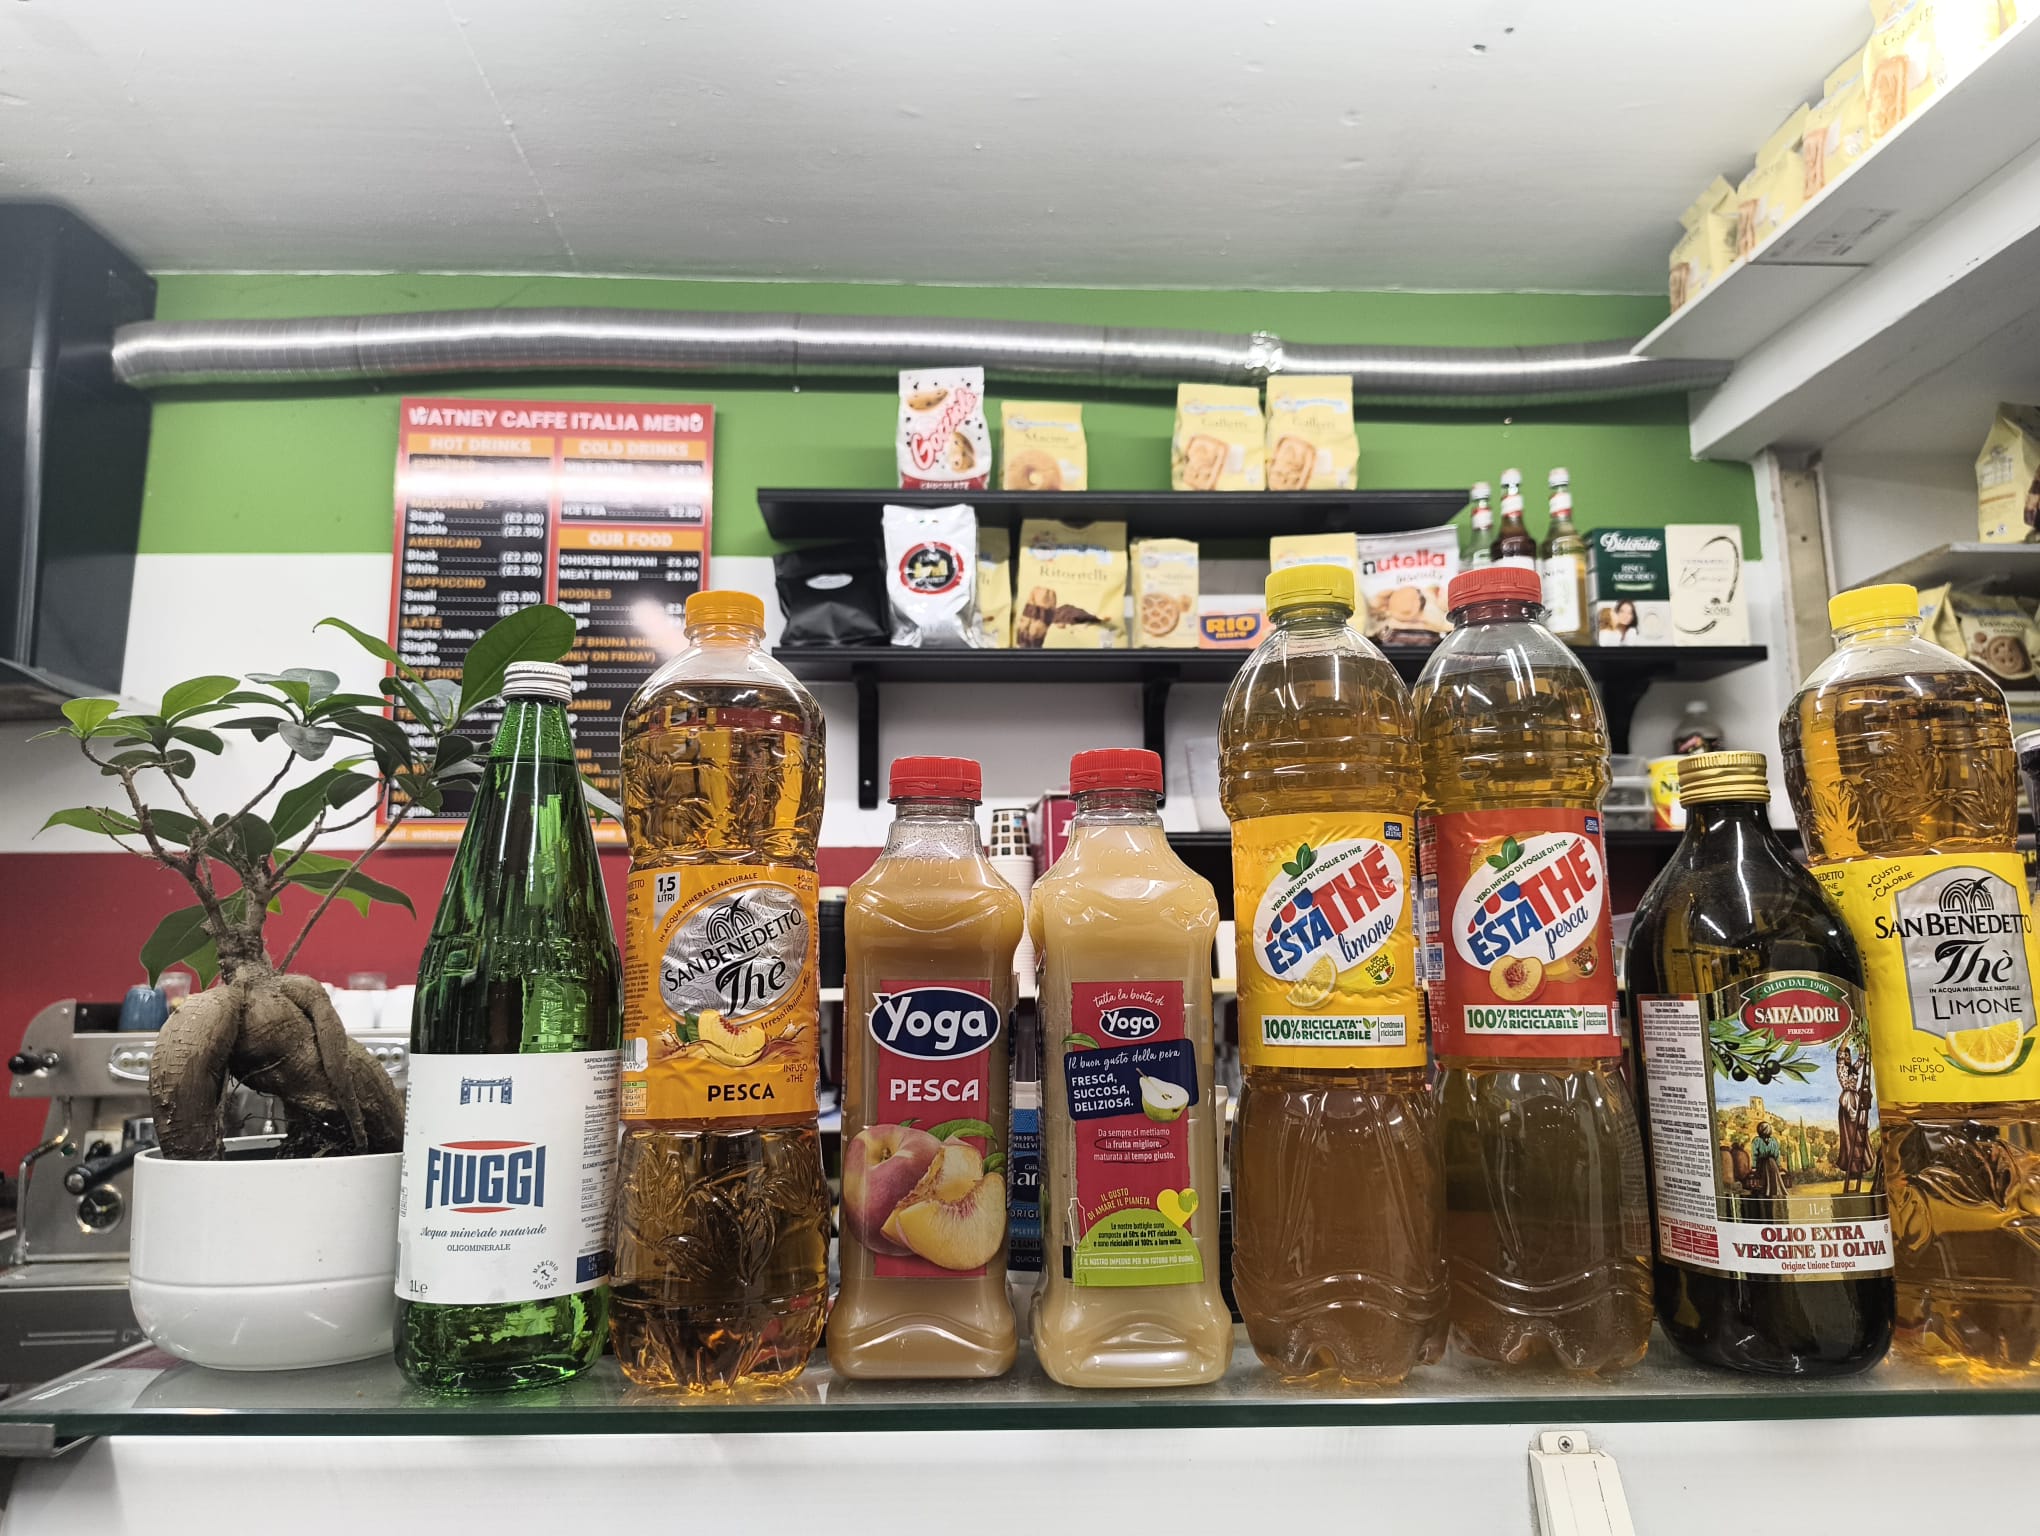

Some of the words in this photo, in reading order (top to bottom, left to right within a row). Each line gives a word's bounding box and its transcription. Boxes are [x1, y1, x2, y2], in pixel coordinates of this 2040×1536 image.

[409, 407, 498, 427] WATNEY
[501, 410, 567, 429] CAFFE
[571, 412, 639, 431] ITALIA
[430, 438, 465, 451] HOT
[468, 438, 532, 452] DRINKS
[578, 440, 624, 455] COLD
[627, 443, 688, 457] DRINKS
[408, 510, 446, 523] Single
[407, 523, 449, 535] Double
[407, 537, 482, 549] AMERICANO
[588, 532, 624, 546] OUR
[627, 533, 673, 547] FOOD
[1363, 549, 1445, 575] nutella
[405, 577, 486, 589] CAPPUCCINO
[559, 569, 591, 580] MEAT
[593, 569, 639, 581] BIRYANI
[402, 616, 442, 628] LATTE
[1205, 615, 1256, 633] RIO
[592, 651, 609, 662] ON
[1271, 895, 1287, 912] VERO
[1286, 877, 1308, 898] INFUSO
[1307, 870, 1316, 881] DI
[1315, 856, 1340, 875] FOGLIE
[1339, 851, 1349, 861] DI
[1474, 886, 1491, 904] VERO
[1490, 869, 1515, 889] INFUSO
[1514, 863, 1524, 872] DI
[1523, 849, 1548, 868] FOGLIE
[1547, 845, 1556, 854] DI
[657, 875, 676, 894] 1,5
[657, 893, 675, 902] LITRI
[658, 933, 665, 942] IN
[663, 910, 683, 936] ACQUA
[682, 884, 718, 911] MINERALE
[717, 872, 759, 889] NATURALE
[1545, 905, 1588, 960] pesca
[1875, 916, 1927, 939] SAN
[1925, 912, 2032, 936] BENEDETTO
[1338, 913, 1394, 963] limone
[664, 959, 705, 992] SAN
[701, 908, 801, 969] BENEDETTO
[1118, 988, 1128, 1000] la
[1763, 981, 1787, 994] OLIO
[1788, 978, 1808, 989] DAL
[1809, 980, 1830, 993] 1900
[1754, 1004, 1840, 1025] SALVADORI
[1932, 996, 2023, 1020] LIMONE
[877, 996, 988, 1050] Yoga
[1105, 1010, 1155, 1035] Yoga
[1467, 1008, 1507, 1029] 100%
[1508, 1019, 1579, 1029] RICICLABILE
[1264, 1019, 1301, 1040] 100%
[1301, 1030, 1371, 1040] RICICLABILE
[1787, 1027, 1814, 1035] FIRENZE
[1080, 1056, 1101, 1068] buon
[1104, 1051, 1129, 1071] gusto
[1132, 1048, 1157, 1063] della
[1159, 1048, 1181, 1061] pera
[783, 1063, 808, 1073] INFUSO
[1899, 1064, 1945, 1073] INFUSO
[1071, 1073, 1117, 1087] FRESCA,
[707, 1083, 775, 1101] PESCA
[890, 1078, 979, 1101] PESCA
[1073, 1085, 1130, 1099] SUCCOSA,
[1075, 1097, 1134, 1112] DELIZIOSA.
[1098, 1128, 1107, 1137] Da
[1108, 1129, 1132, 1139] sempre
[1140, 1128, 1170, 1136] mettiamo
[1113, 1139, 1131, 1148] frutta
[1094, 1152, 1123, 1161] maturata
[1124, 1152, 1130, 1160] al
[1131, 1152, 1152, 1162] tempo
[1153, 1150, 1176, 1161] giusto.
[425, 1144, 546, 1210] FIUGGI
[1100, 1194, 1107, 1202] IL
[1108, 1187, 1129, 1199] GUSTO
[1087, 1211, 1096, 1221] DI
[1095, 1201, 1116, 1216] AMARE
[1124, 1197, 1150, 1206] PIANETA
[420, 1225, 447, 1238] Acqua
[449, 1225, 497, 1239] minerale
[500, 1223, 547, 1238] naturale
[1760, 1226, 1806, 1242] OLIO
[1810, 1225, 1865, 1241] EXTRA
[446, 1243, 511, 1252] OLIGOMINERALE
[1733, 1242, 1816, 1259] VERGINE
[1821, 1242, 1839, 1258] DI
[1842, 1240, 1886, 1256] OLIVA
[1781, 1260, 1806, 1271] Origine
[1807, 1260, 1829, 1270] Unione
[1830, 1260, 1856, 1271] Europea
